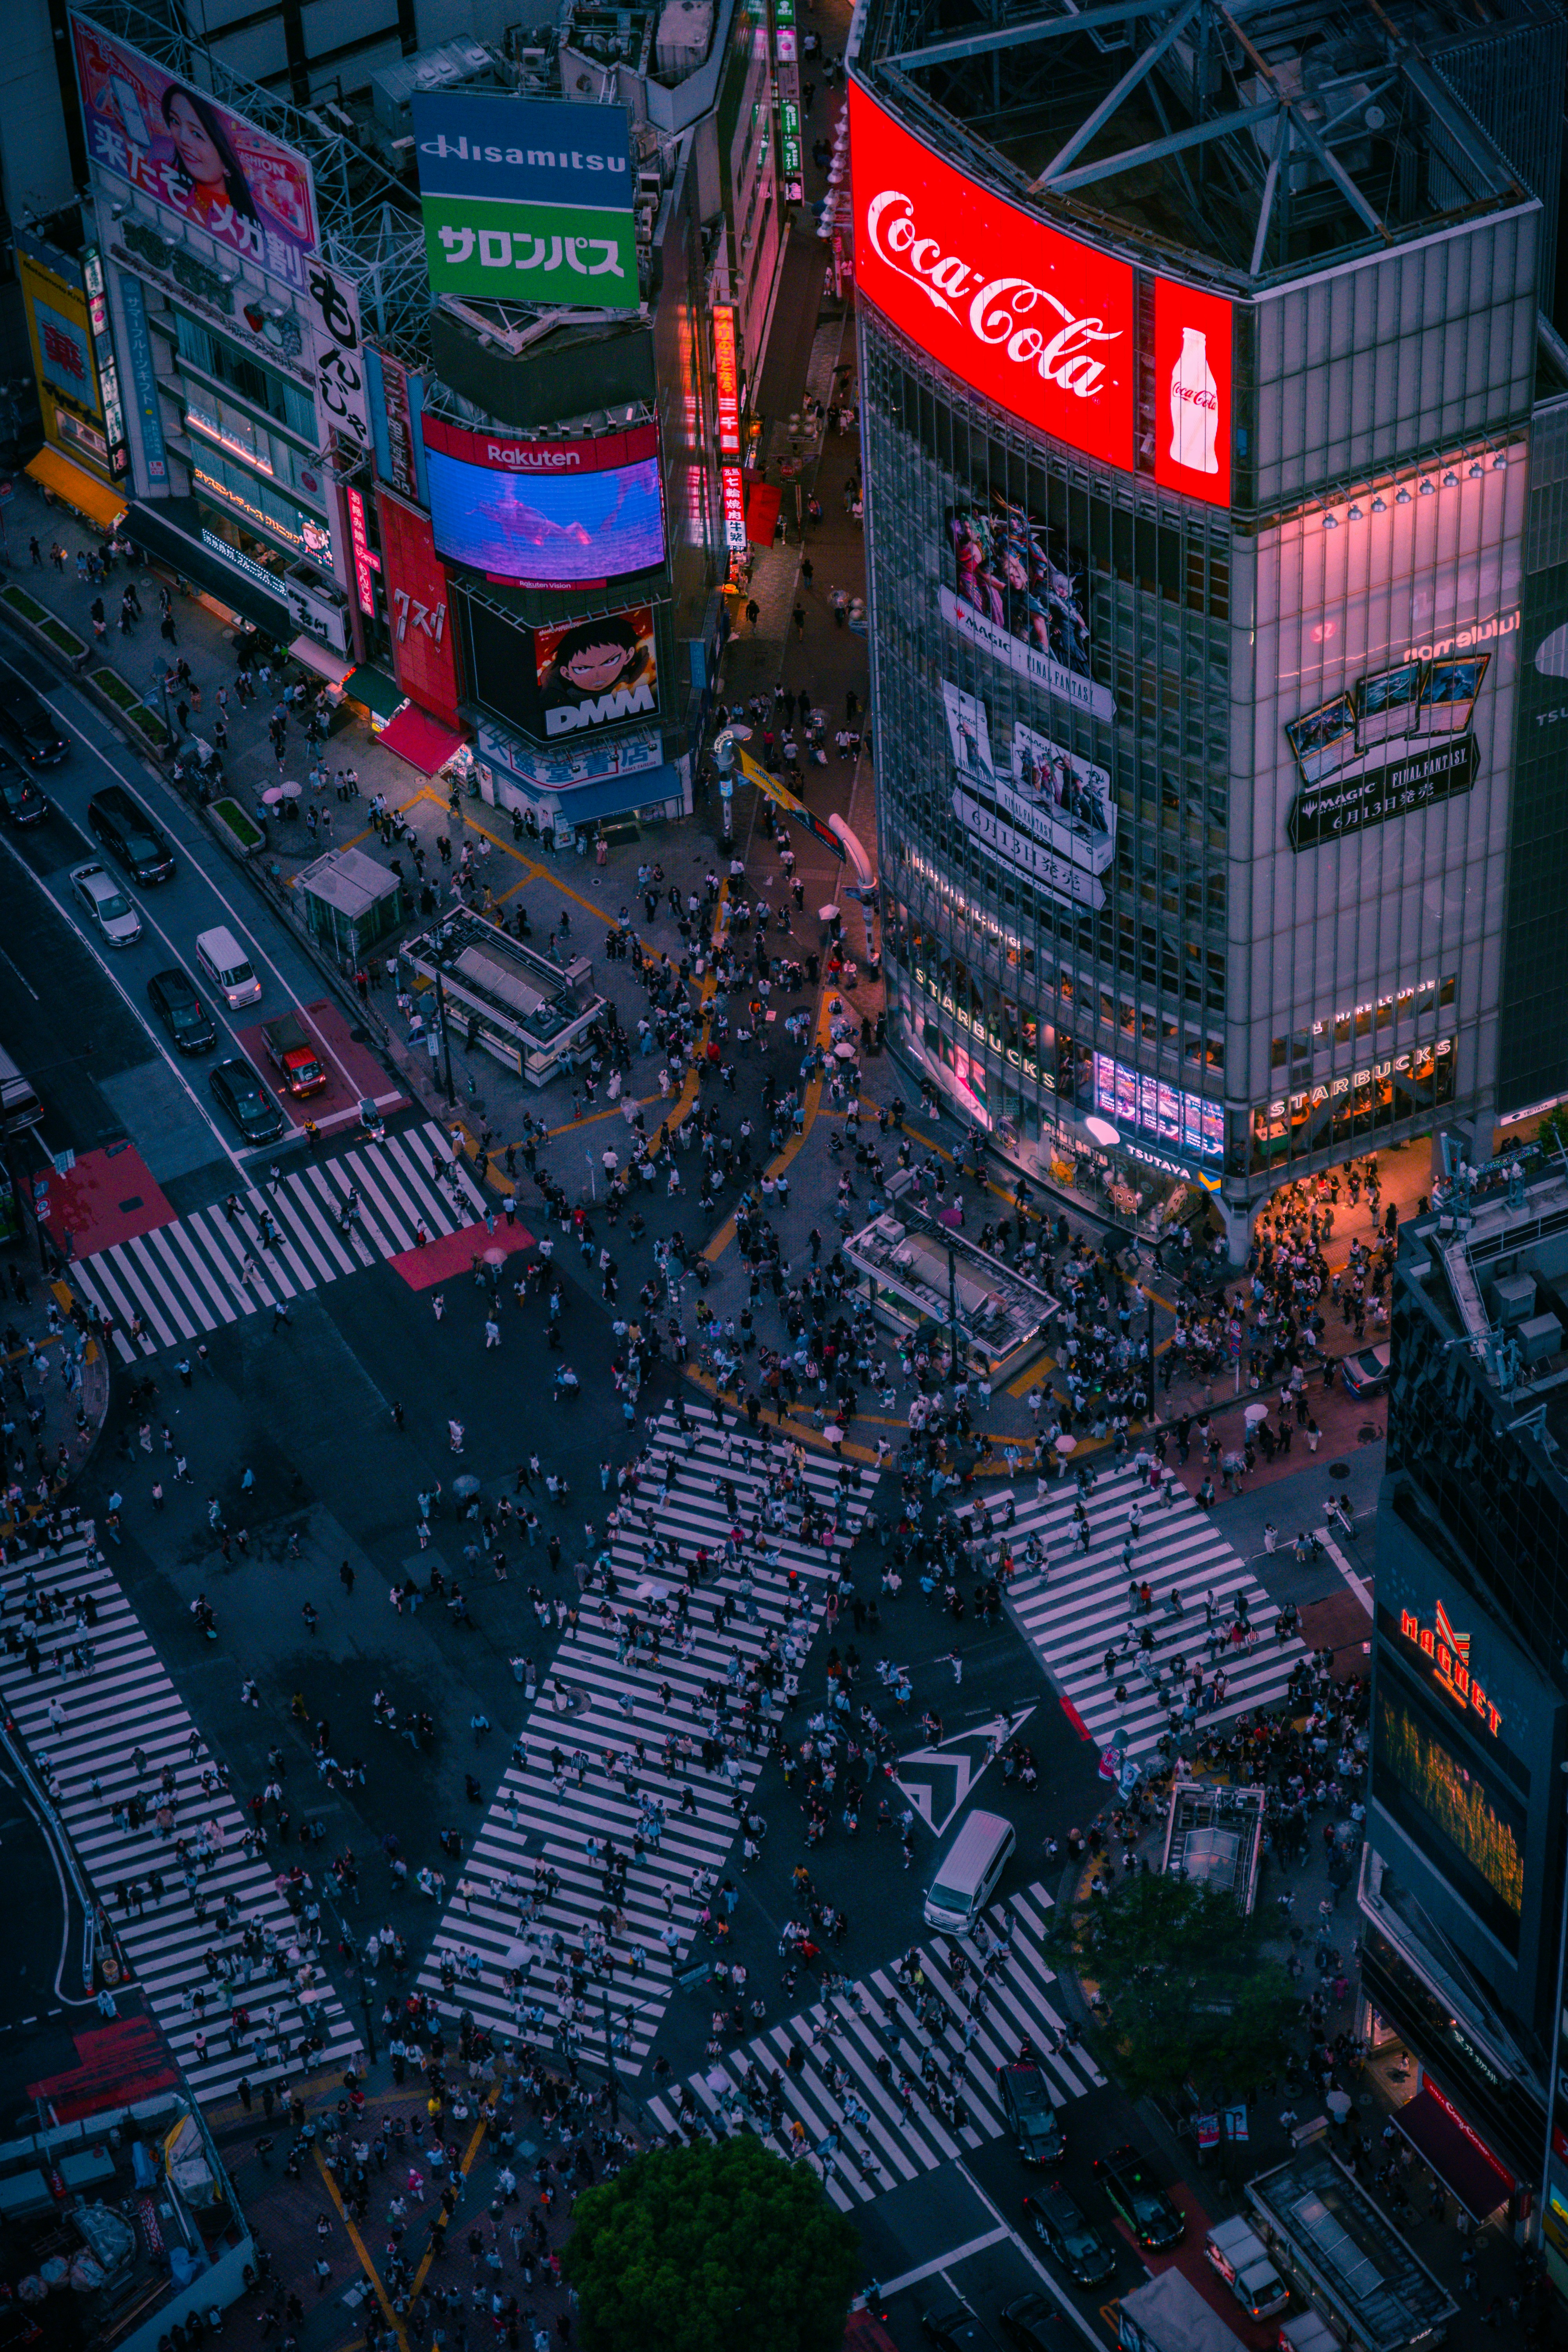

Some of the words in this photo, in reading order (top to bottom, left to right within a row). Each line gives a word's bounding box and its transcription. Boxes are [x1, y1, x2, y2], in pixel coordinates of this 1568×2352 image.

[420, 134, 626, 172] Hisamitsu
[438, 225, 624, 278] サロンパス
[867, 190, 1124, 397] Coca-Cola
[309, 269, 366, 441] もんじゃ
[1172, 381, 1216, 410] Coca-Cola
[487, 444, 580, 466] Rakuten
[726, 477, 742, 520] 七輪焼肉
[730, 521, 743, 543] 牛繁
[519, 580, 548, 589] Rakuten
[965, 617, 1011, 654] MAGIC
[1027, 655, 1052, 682] FINAL
[1055, 671, 1093, 704] FANTASY
[545, 684, 656, 728] DMM
[1392, 766, 1421, 787] FINAL
[1423, 748, 1467, 774] FANTASY
[1319, 782, 1377, 811] MAGIC
[1332, 782, 1435, 830] 6月13日発売
[972, 810, 1081, 893] 6月13日発売
[914, 967, 1056, 1089] STARBUCKS
[1270, 1039, 1452, 1118] STARBUCKS
[1523, 1104, 1548, 1116] TSUTAYA
[1125, 1143, 1191, 1180] TSUTAYA
[1401, 1609, 1503, 1738] MAGNET
